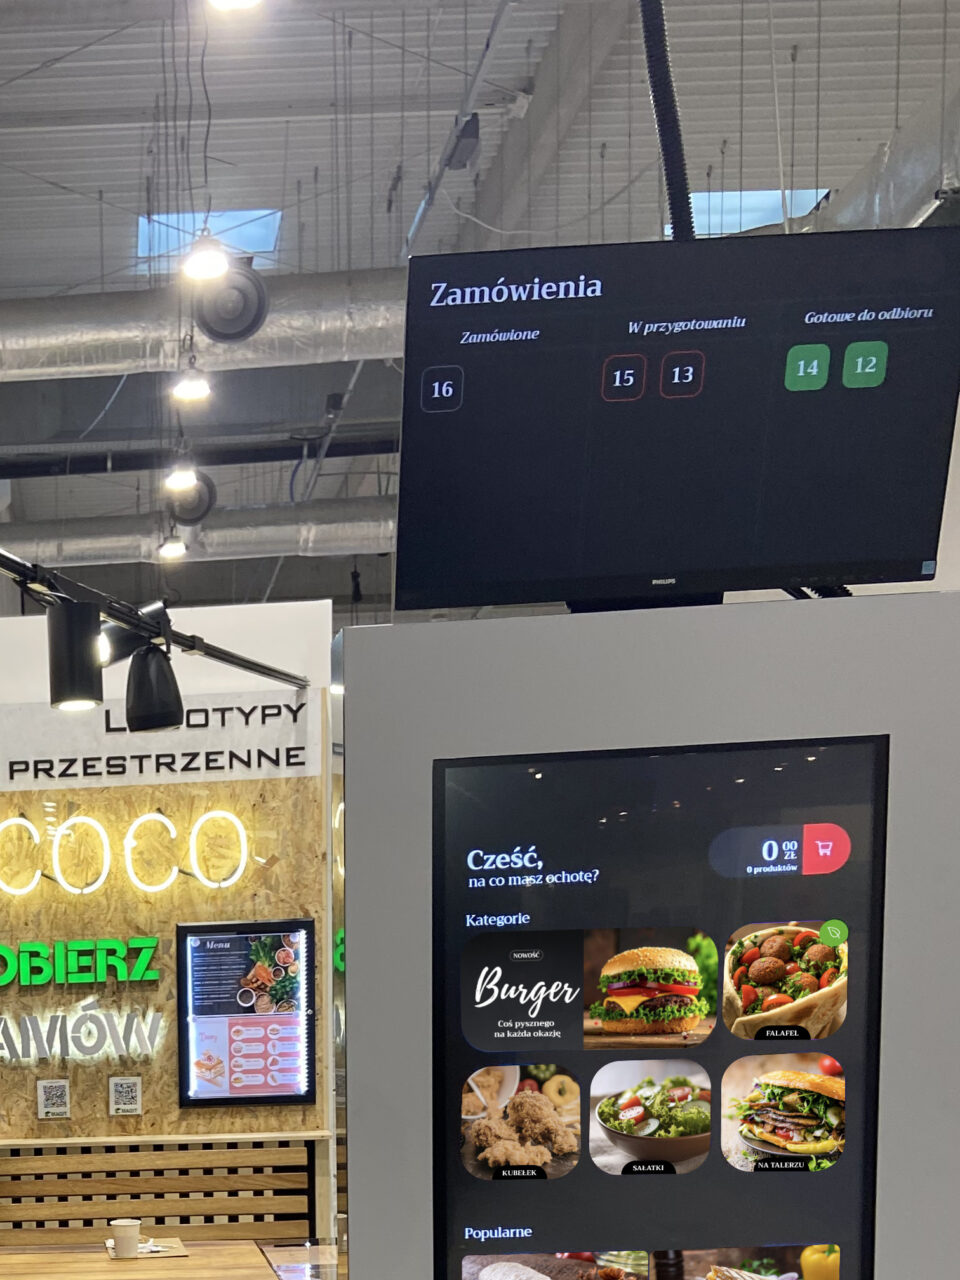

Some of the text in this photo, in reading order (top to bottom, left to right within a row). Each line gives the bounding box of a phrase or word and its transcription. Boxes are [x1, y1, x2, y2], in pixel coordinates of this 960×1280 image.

[430, 275, 602, 306] Zamówienia
[804, 307, 934, 324] Gotowe do odbioru
[628, 316, 746, 336] W przygotowaniu
[460, 329, 540, 344] Zamówione
[796, 360, 819, 377] 14
[855, 356, 877, 374] 12
[612, 369, 635, 387] 15
[671, 366, 694, 383] 13
[432, 381, 453, 398] 16
[105, 703, 306, 733] LOTYPY
[8, 747, 306, 780] PRZESTRZENNE
[762, 840, 779, 861] 0
[782, 840, 798, 851] 00
[467, 846, 543, 870] Cześć,
[753, 863, 797, 875] produktów
[468, 869, 600, 888] na co masz ochotę?
[465, 913, 531, 927] Kategorie
[206, 940, 230, 949] Menu
[512, 951, 540, 959] NOWOŚĆ
[474, 966, 581, 1019] Burger
[497, 1020, 555, 1029] Coś pysznego
[765, 1029, 800, 1037] FALAFEL
[533, 1030, 561, 1039] okazję
[502, 1168, 538, 1177] KUBEŁEK
[632, 1164, 664, 1172] SAŁATKI
[757, 1160, 806, 1169] NA TALERZU
[464, 1226, 533, 1241] Popularne
